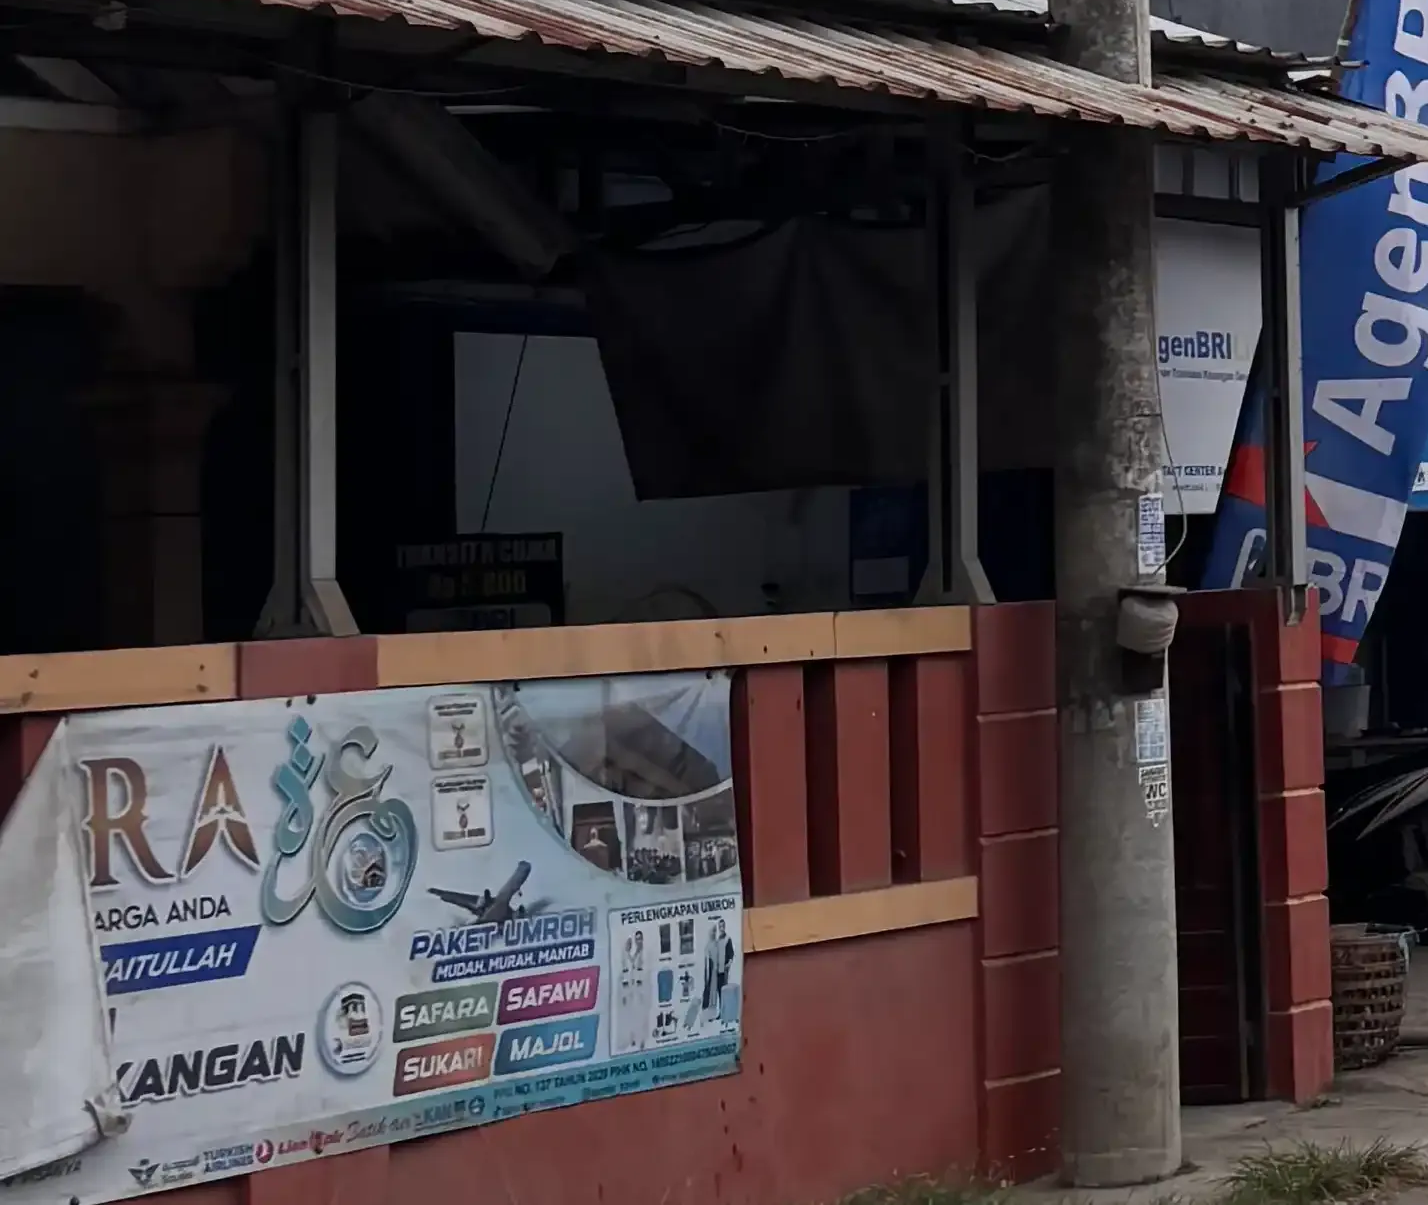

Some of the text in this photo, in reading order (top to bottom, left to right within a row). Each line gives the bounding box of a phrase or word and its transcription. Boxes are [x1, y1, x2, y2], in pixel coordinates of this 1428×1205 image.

[164, 893, 233, 926] ANDA
[620, 898, 737, 926] PERLENGKAPAN UMROH
[409, 907, 597, 962] PAKET UMROH
[537, 943, 590, 966] MANTAB
[398, 977, 591, 1031] SAFARA SAFAWI
[402, 1030, 586, 1083] SUKARI MAJOL
